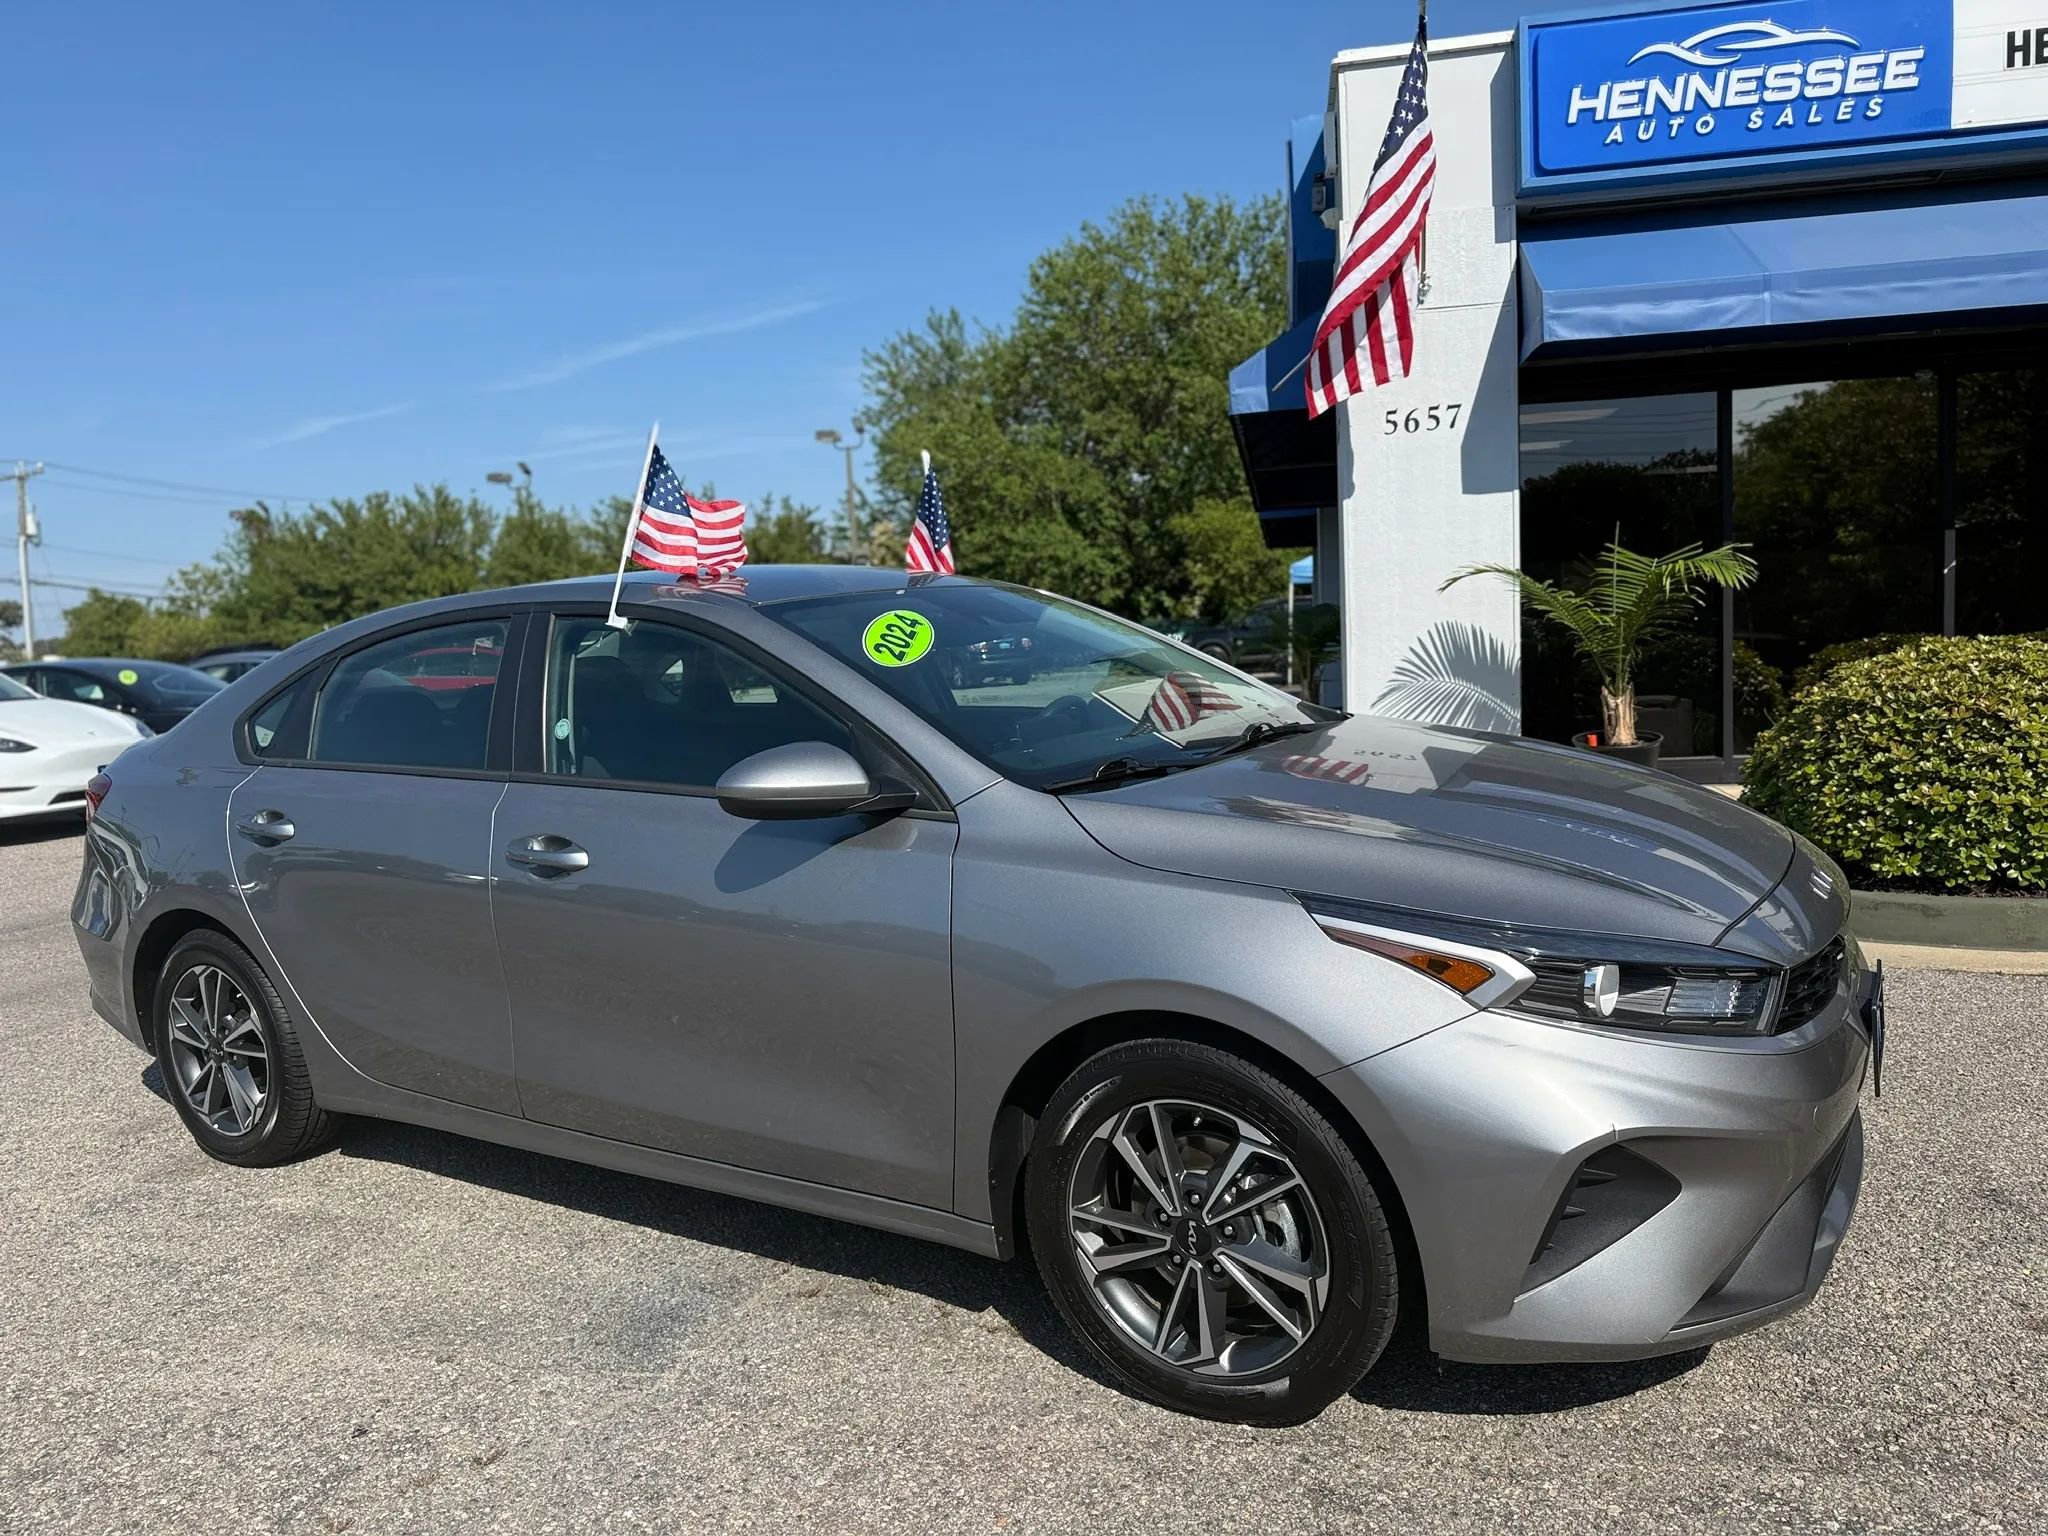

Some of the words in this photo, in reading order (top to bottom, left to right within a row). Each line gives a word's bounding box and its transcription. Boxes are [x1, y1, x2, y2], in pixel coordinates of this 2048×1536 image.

[1567, 47, 1925, 125] HENNESSEE
[1605, 115, 1714, 144] AUTO
[1748, 97, 1884, 129] SALES
[1384, 403, 1462, 435] 5657
[873, 612, 924, 662] 2024
